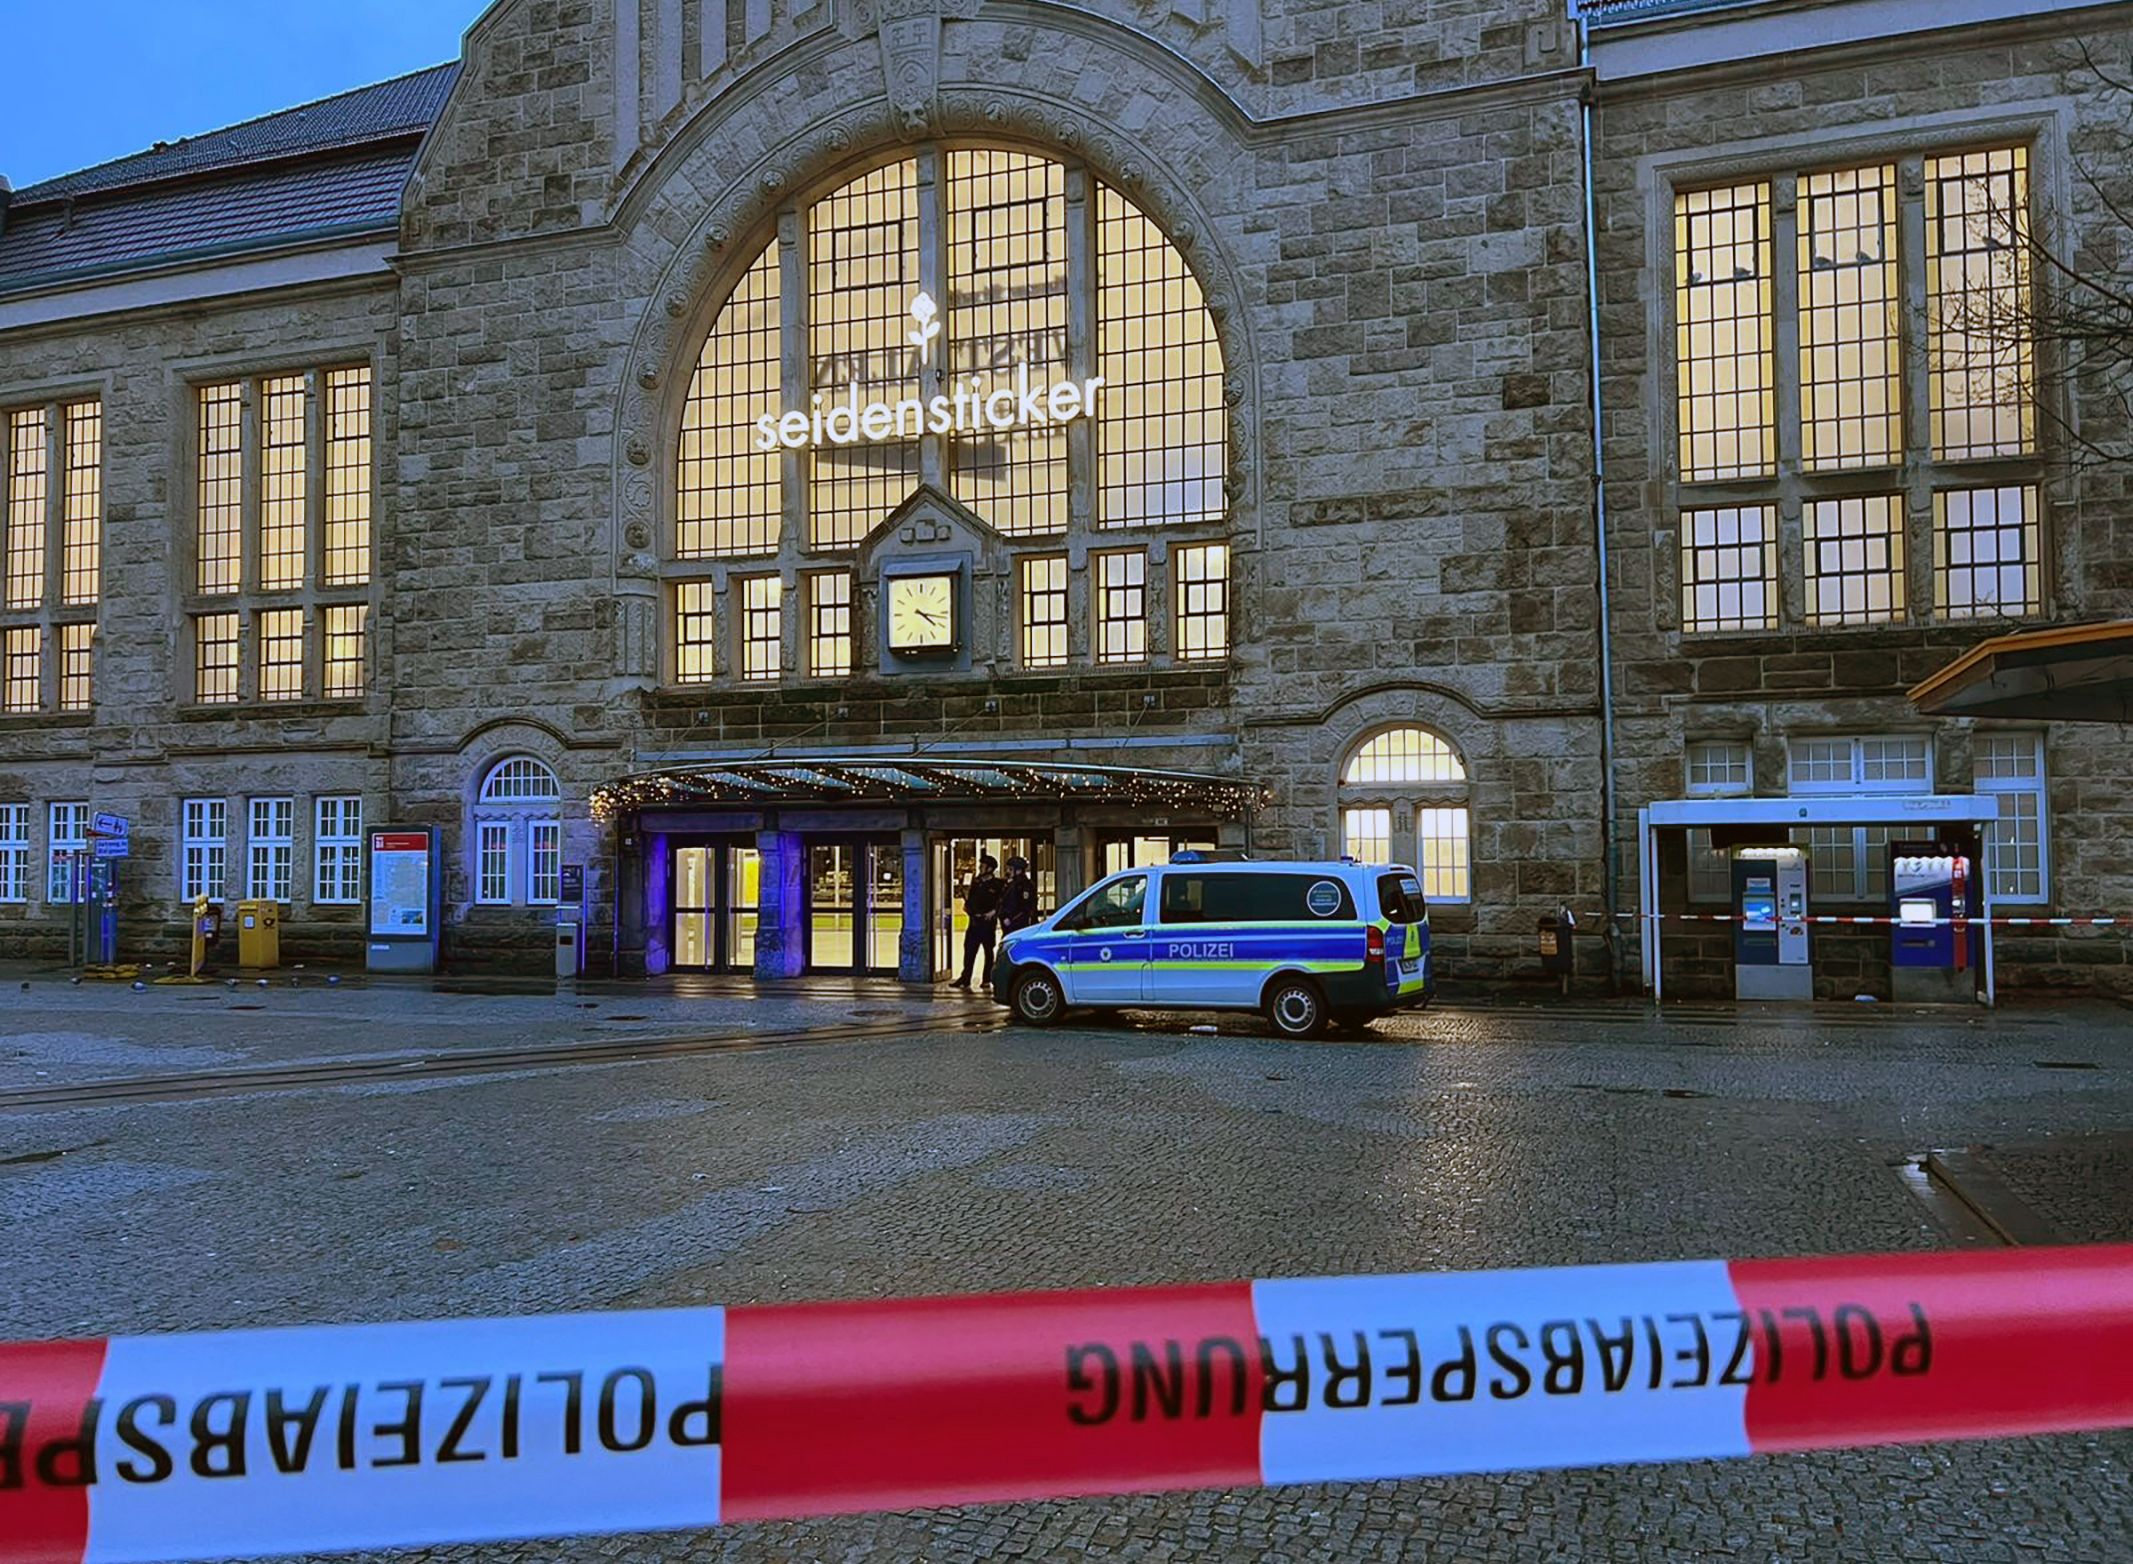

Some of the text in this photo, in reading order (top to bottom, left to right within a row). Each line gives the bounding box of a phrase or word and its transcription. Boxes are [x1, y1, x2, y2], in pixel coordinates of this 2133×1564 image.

[754, 361, 1105, 451] seidensticker
[1168, 943, 1234, 958] POLIZEI
[1063, 1301, 1933, 1426] POLIZEIABSPERRUNG
